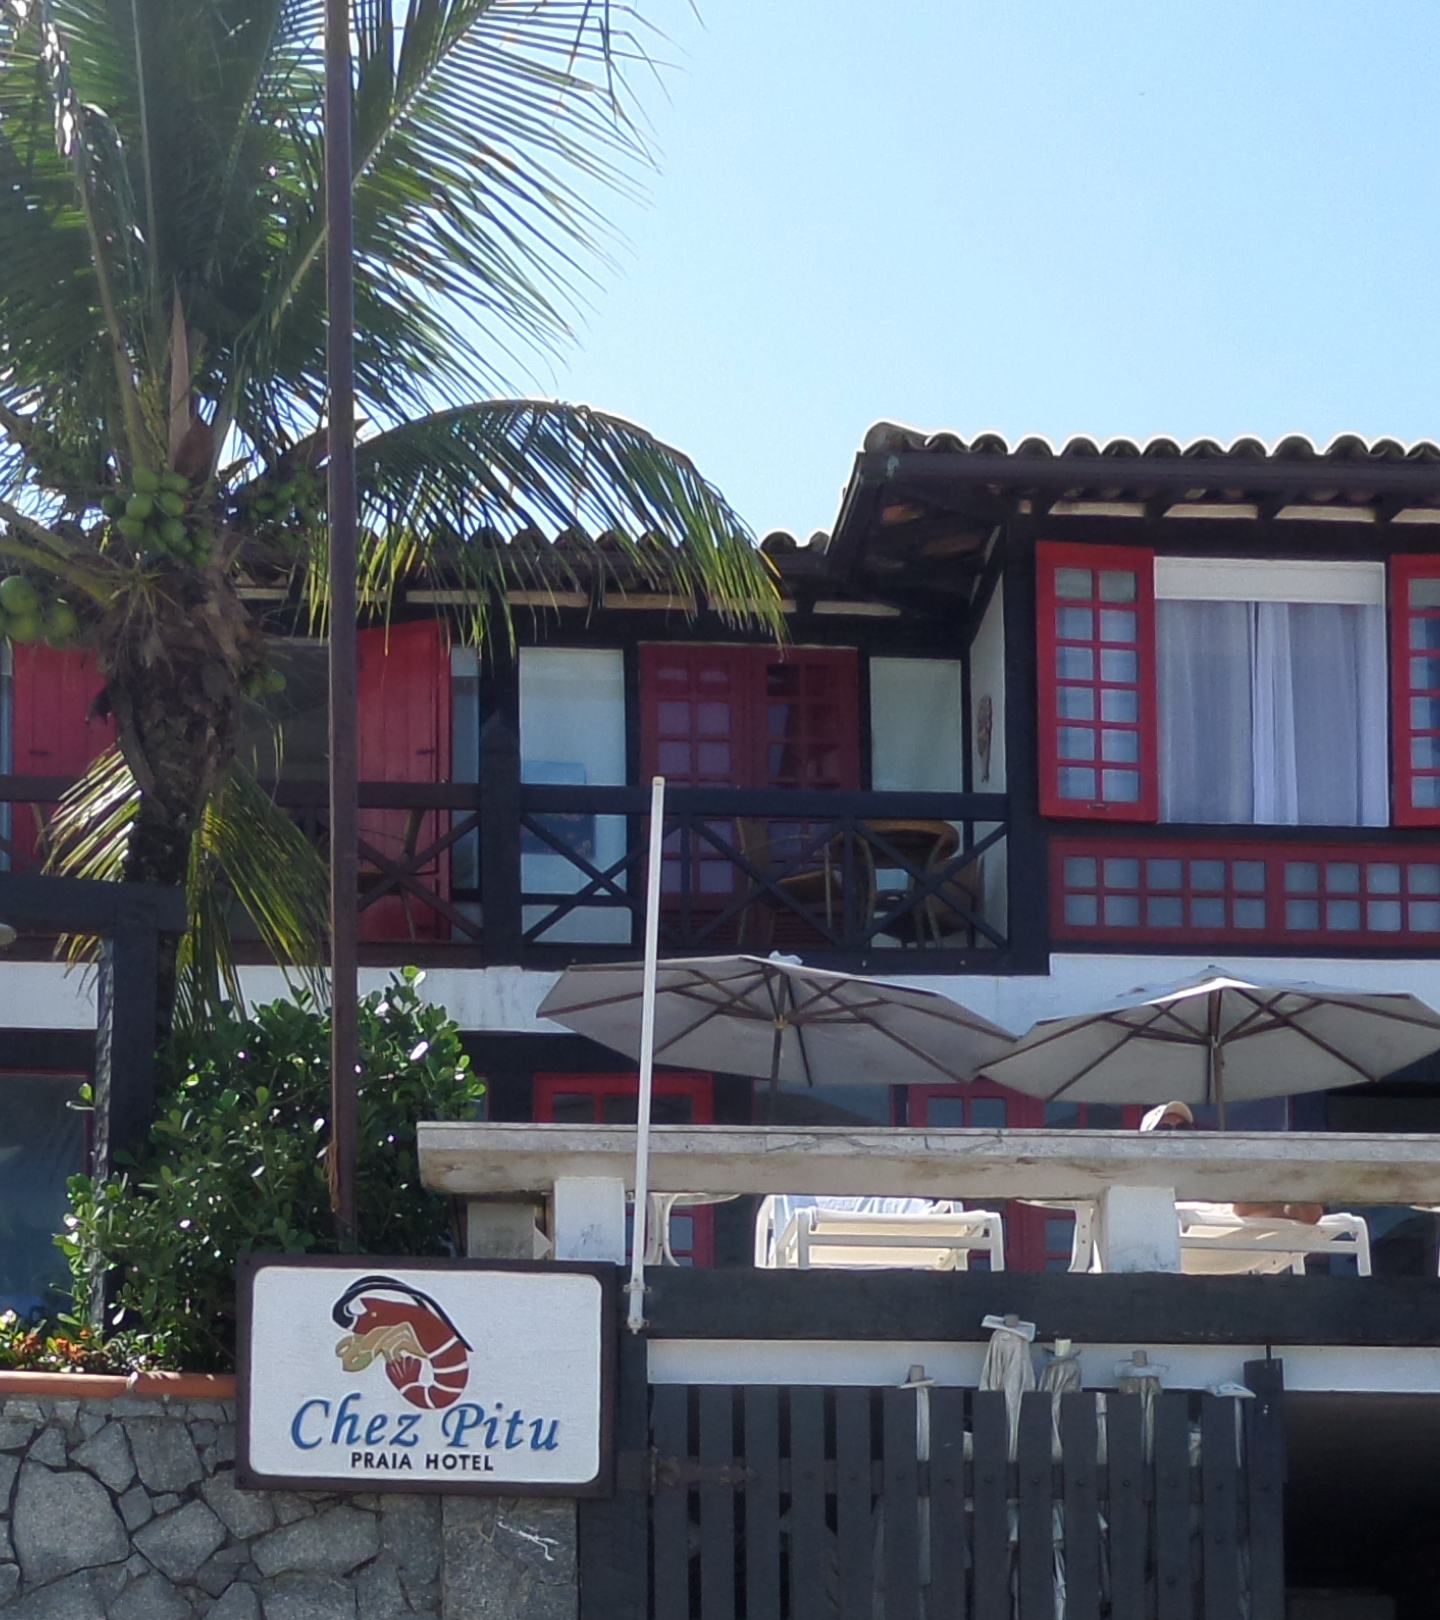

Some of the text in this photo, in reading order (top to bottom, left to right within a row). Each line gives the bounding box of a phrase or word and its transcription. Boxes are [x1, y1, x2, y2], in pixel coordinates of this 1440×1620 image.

[290, 1392, 559, 1451] Chez Pitu
[351, 1451, 494, 1471] PRAIA HOTEL
